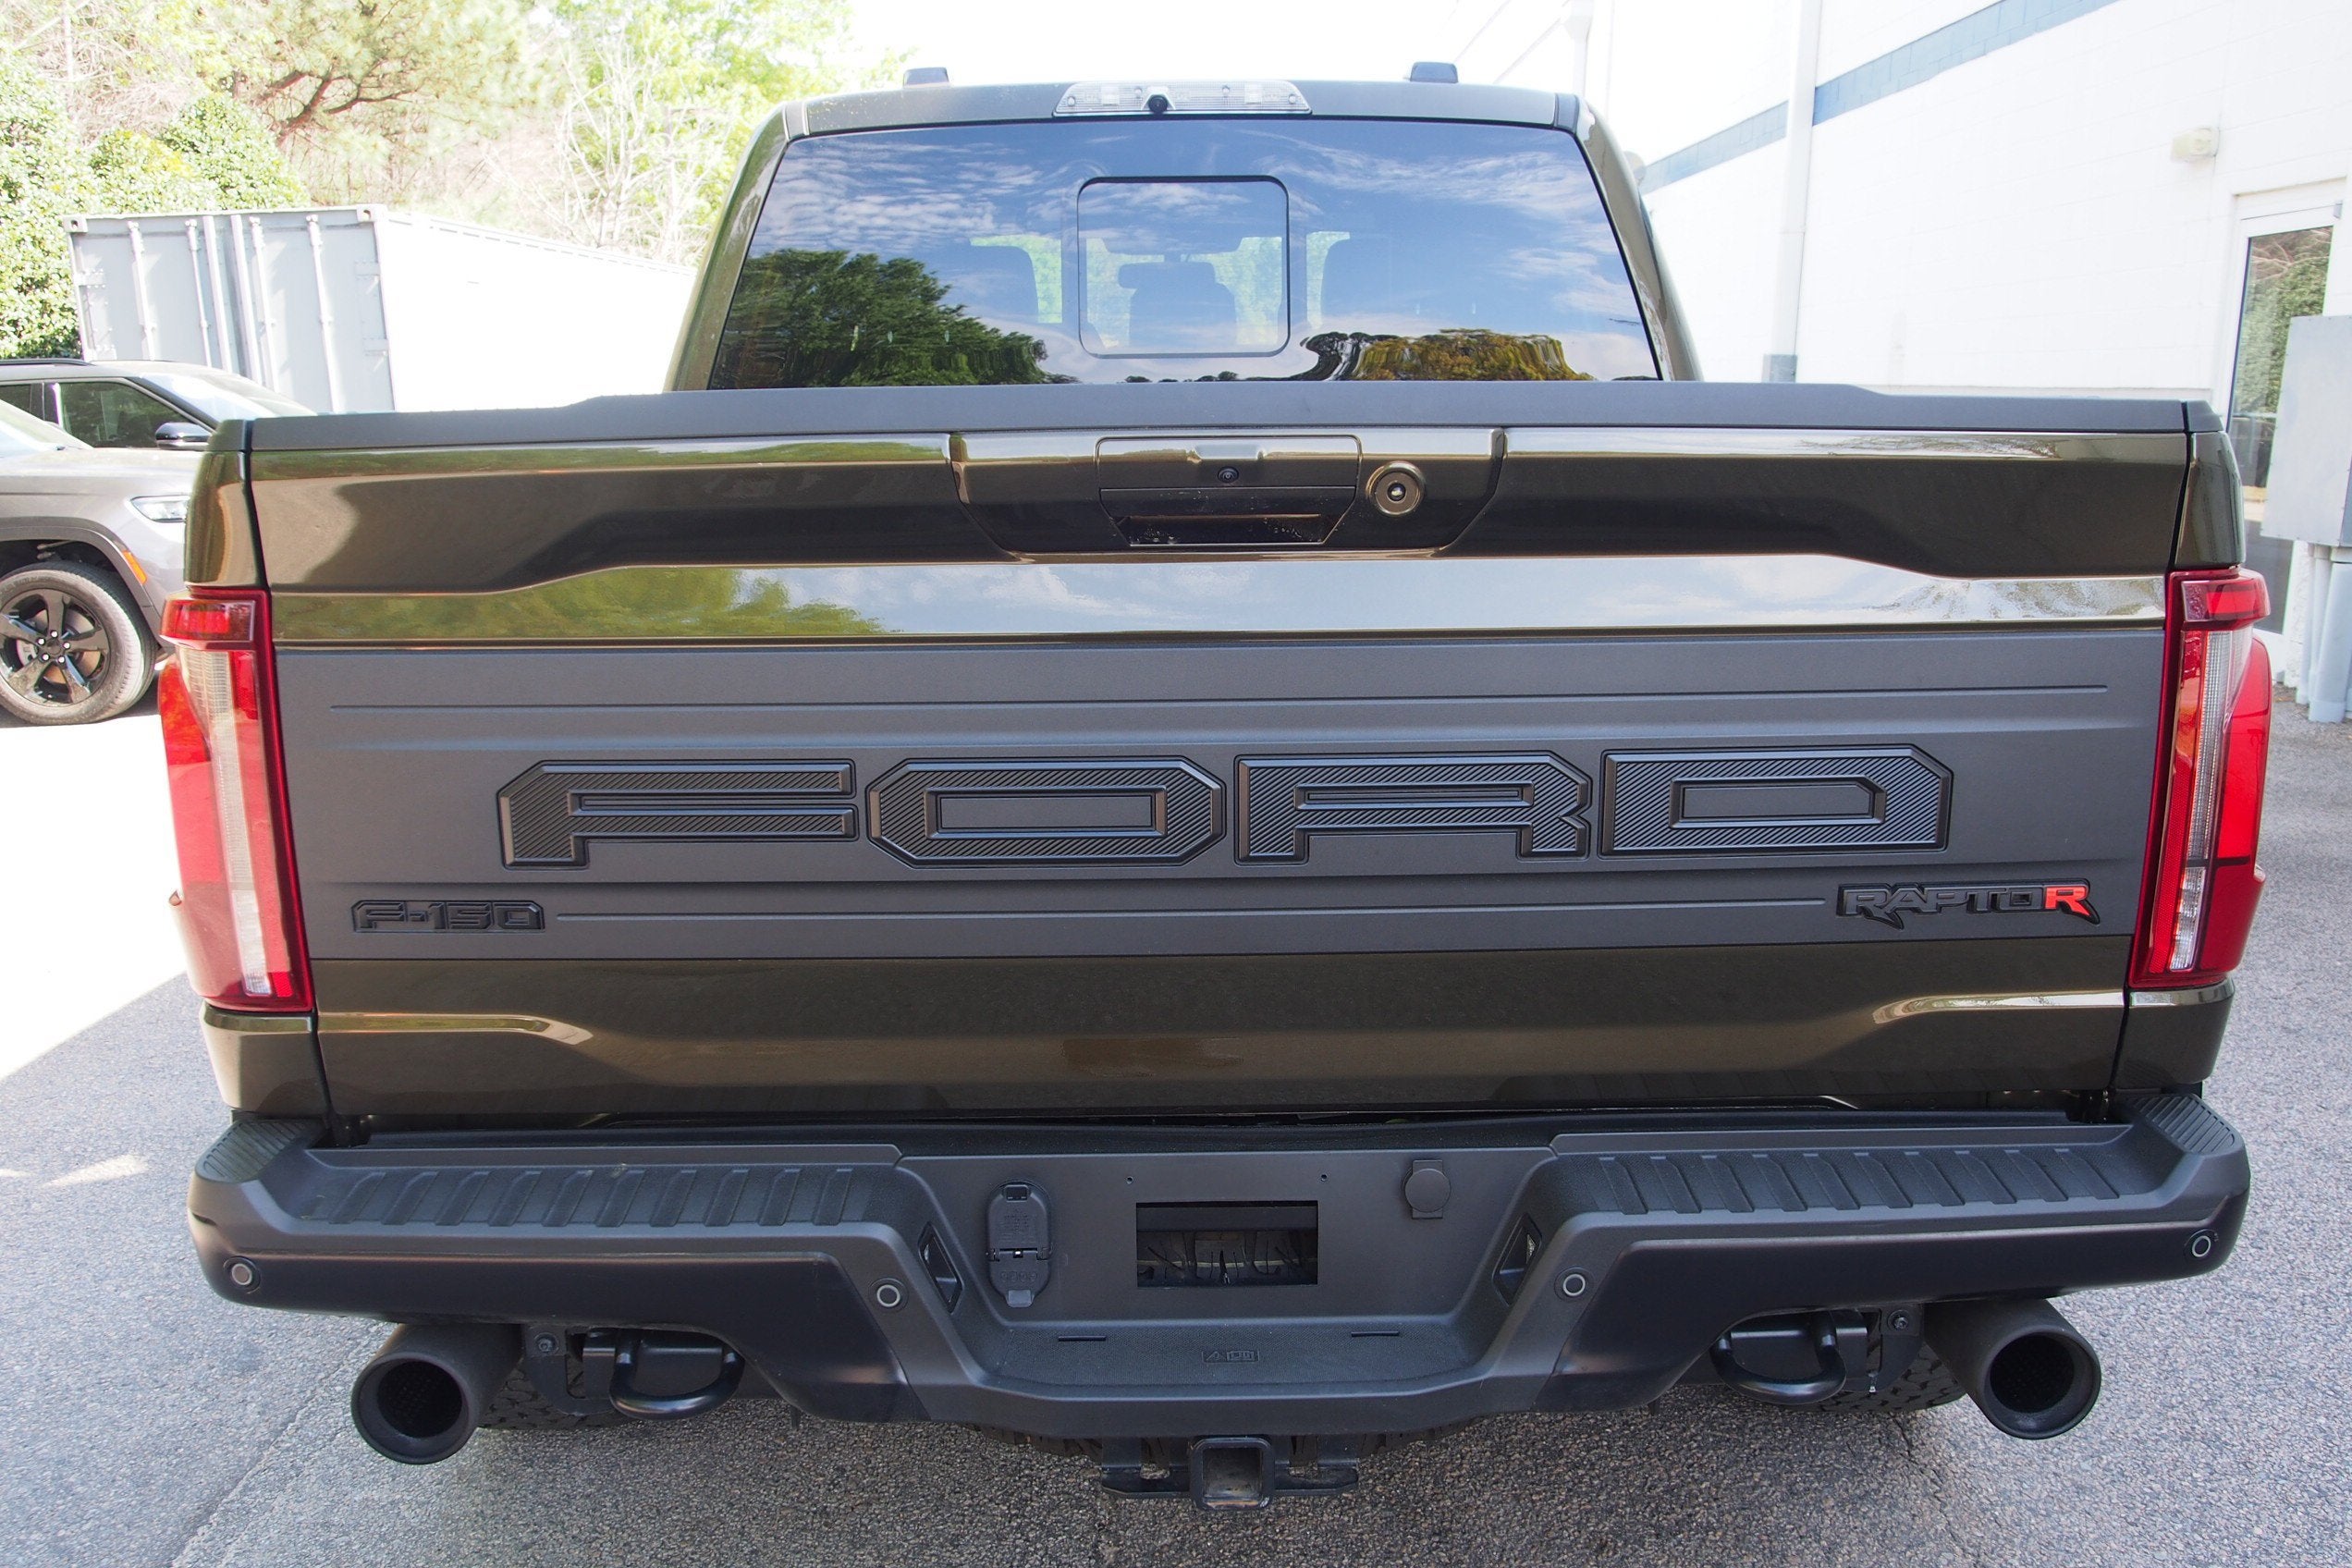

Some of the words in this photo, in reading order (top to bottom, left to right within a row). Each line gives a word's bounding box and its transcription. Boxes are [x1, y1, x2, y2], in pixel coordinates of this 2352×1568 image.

[497, 745, 1954, 867] FORD
[352, 900, 545, 933] F-150
[1837, 879, 2100, 929] RAPTOR
